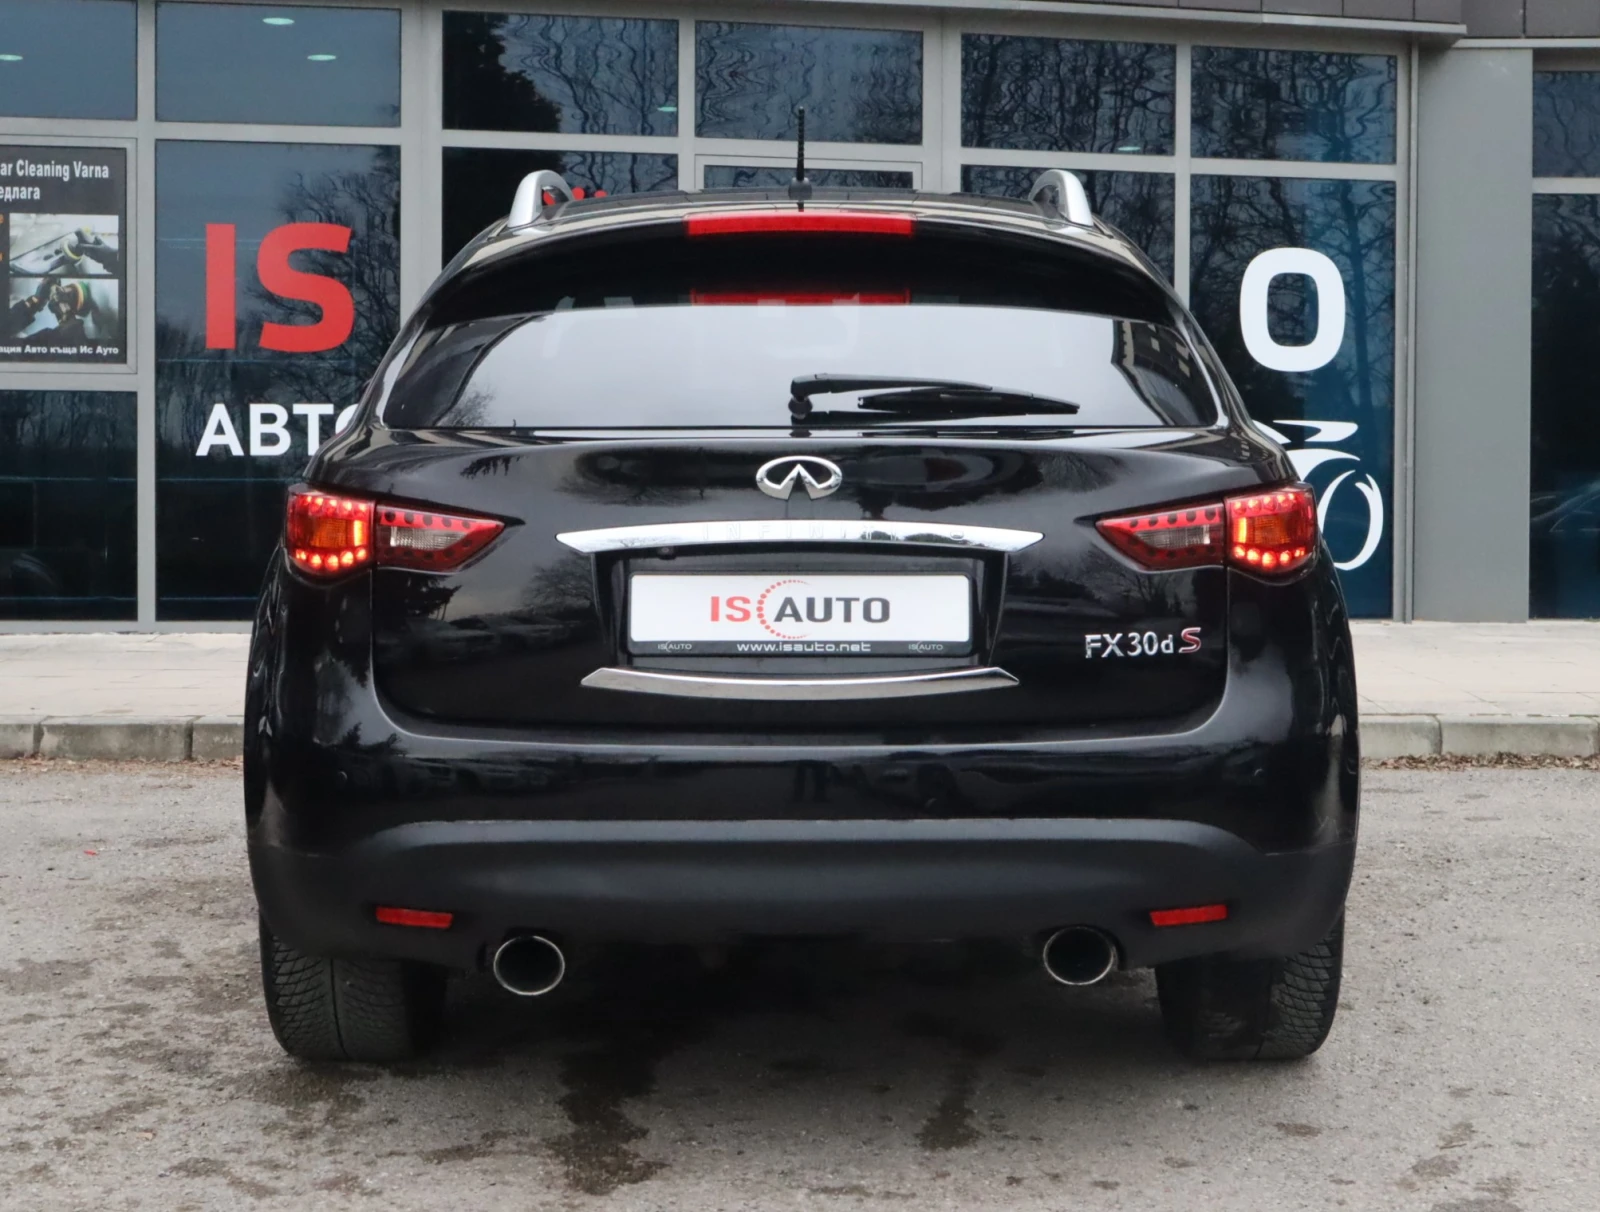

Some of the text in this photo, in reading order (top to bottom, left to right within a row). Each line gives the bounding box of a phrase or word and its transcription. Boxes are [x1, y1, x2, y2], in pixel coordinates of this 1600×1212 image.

[16, 159, 70, 181] Cleaning
[73, 160, 109, 178] Varna
[205, 222, 355, 353] IS
[24, 345, 48, 354] Авто
[96, 345, 119, 356] Ауто
[736, 642, 871, 652] www.isauto.net
